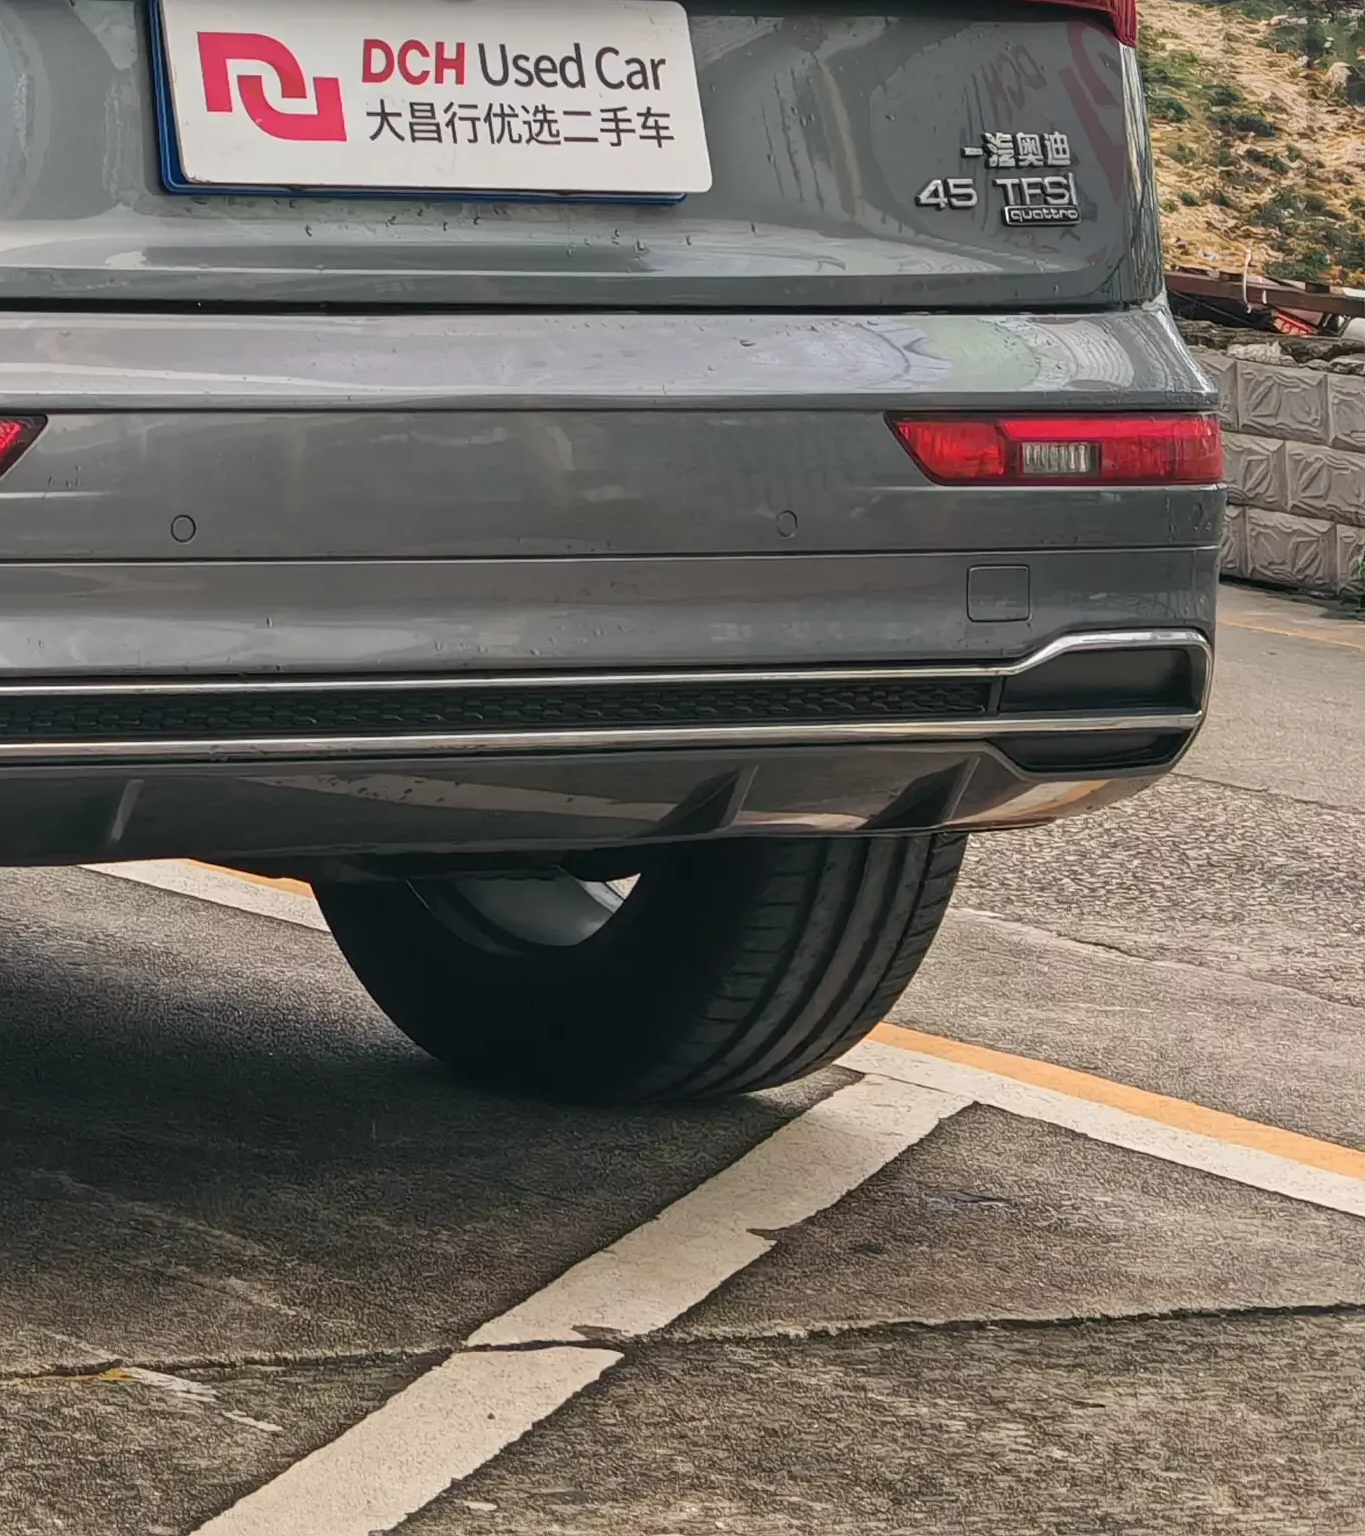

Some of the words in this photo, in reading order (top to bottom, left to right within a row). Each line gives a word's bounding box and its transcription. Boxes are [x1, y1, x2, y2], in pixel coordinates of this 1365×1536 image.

[361, 38, 466, 87] DCH
[478, 40, 586, 90] Used
[595, 46, 666, 91] Car
[365, 98, 675, 149] 大昌行优选二手车
[960, 131, 1071, 168] 一汽奥迪
[915, 177, 978, 211] 45
[993, 171, 1078, 206] TFSI
[1009, 207, 1079, 224] quattro
